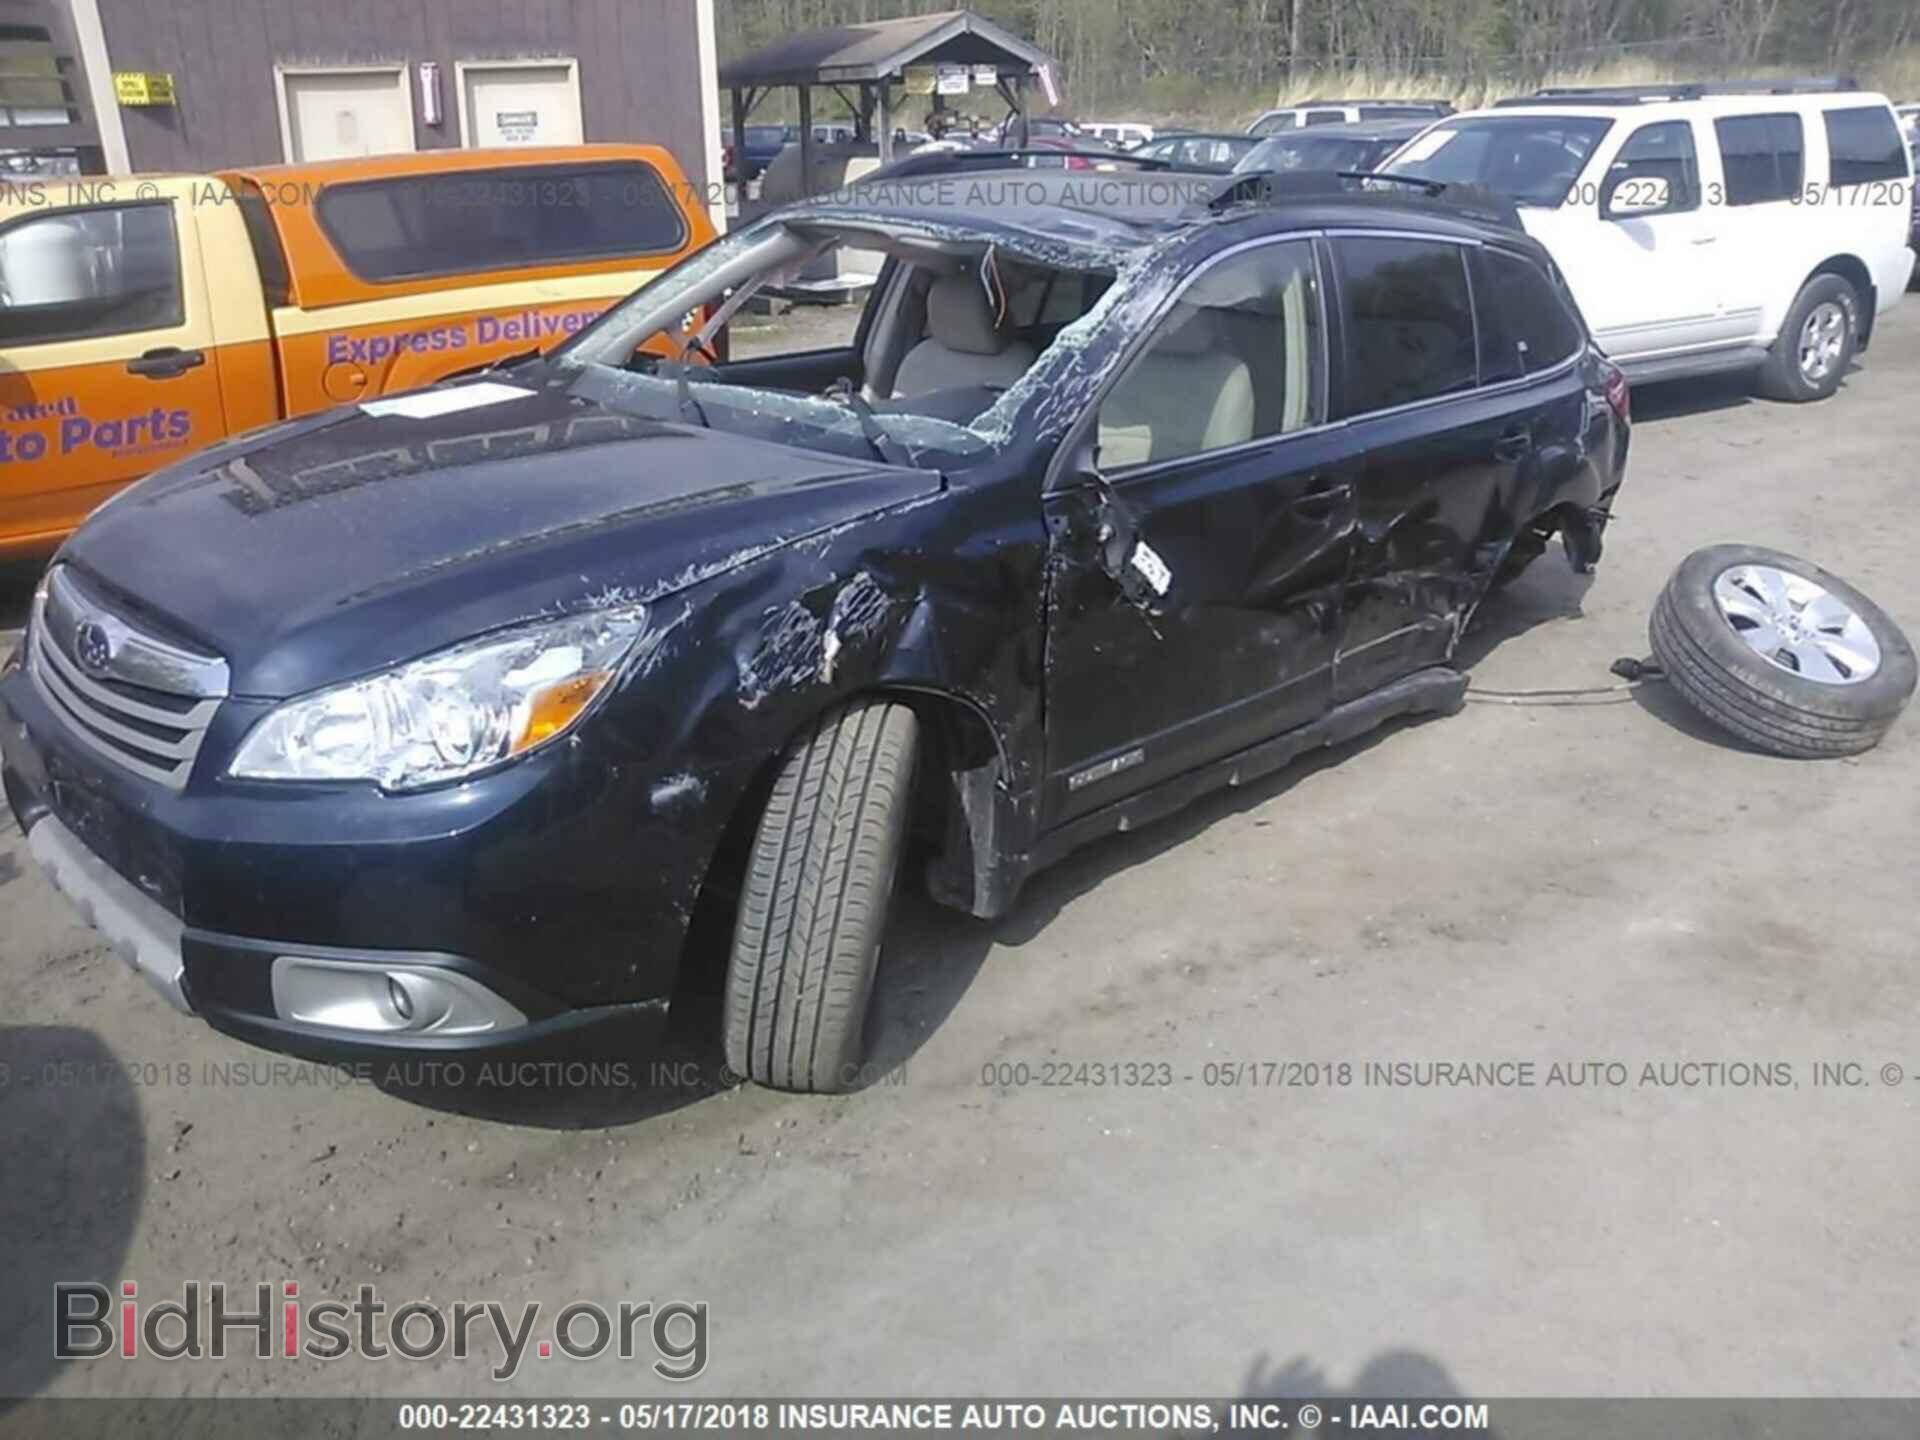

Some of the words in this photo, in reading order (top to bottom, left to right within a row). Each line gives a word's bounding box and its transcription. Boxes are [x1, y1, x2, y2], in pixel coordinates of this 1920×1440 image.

[327, 325, 466, 366] Express
[478, 310, 607, 344] Deliver
[61, 408, 191, 455] Parts
